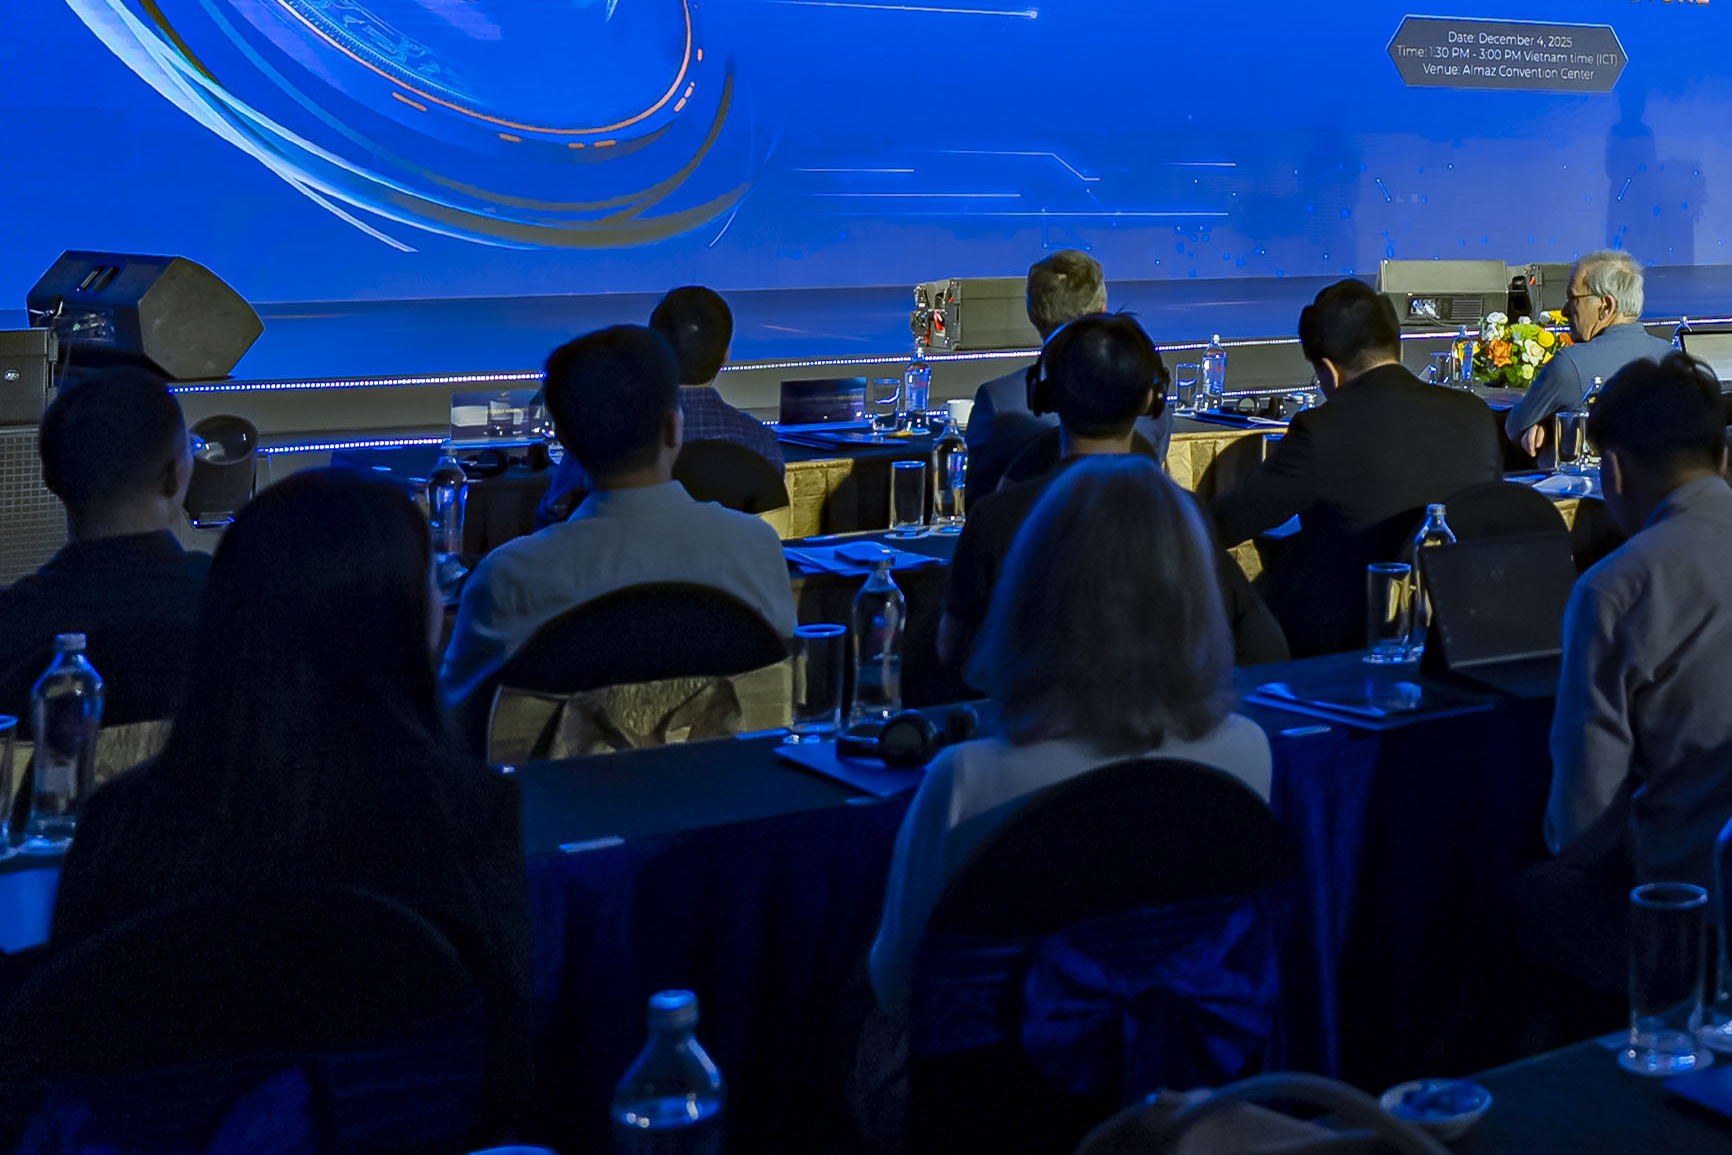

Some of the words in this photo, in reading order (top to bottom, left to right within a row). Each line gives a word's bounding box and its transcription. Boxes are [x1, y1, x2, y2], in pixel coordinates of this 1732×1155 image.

[1448, 31, 1476, 44] Date:
[1478, 32, 1534, 46] December
[1536, 36, 1547, 48] 4,
[1548, 36, 1573, 47] 2025
[1397, 45, 1427, 58] Time:
[1452, 47, 1470, 59] PM
[1479, 48, 1502, 60] 3:00
[1504, 49, 1521, 61] PM
[1523, 50, 1568, 63] Vietnam
[1570, 53, 1594, 64] time
[1596, 54, 1618, 67] (ICT)
[1422, 62, 1460, 76] Venue:
[1462, 64, 1497, 77] Almaz
[1498, 65, 1558, 79] Convention
[1560, 67, 1594, 80] Center
